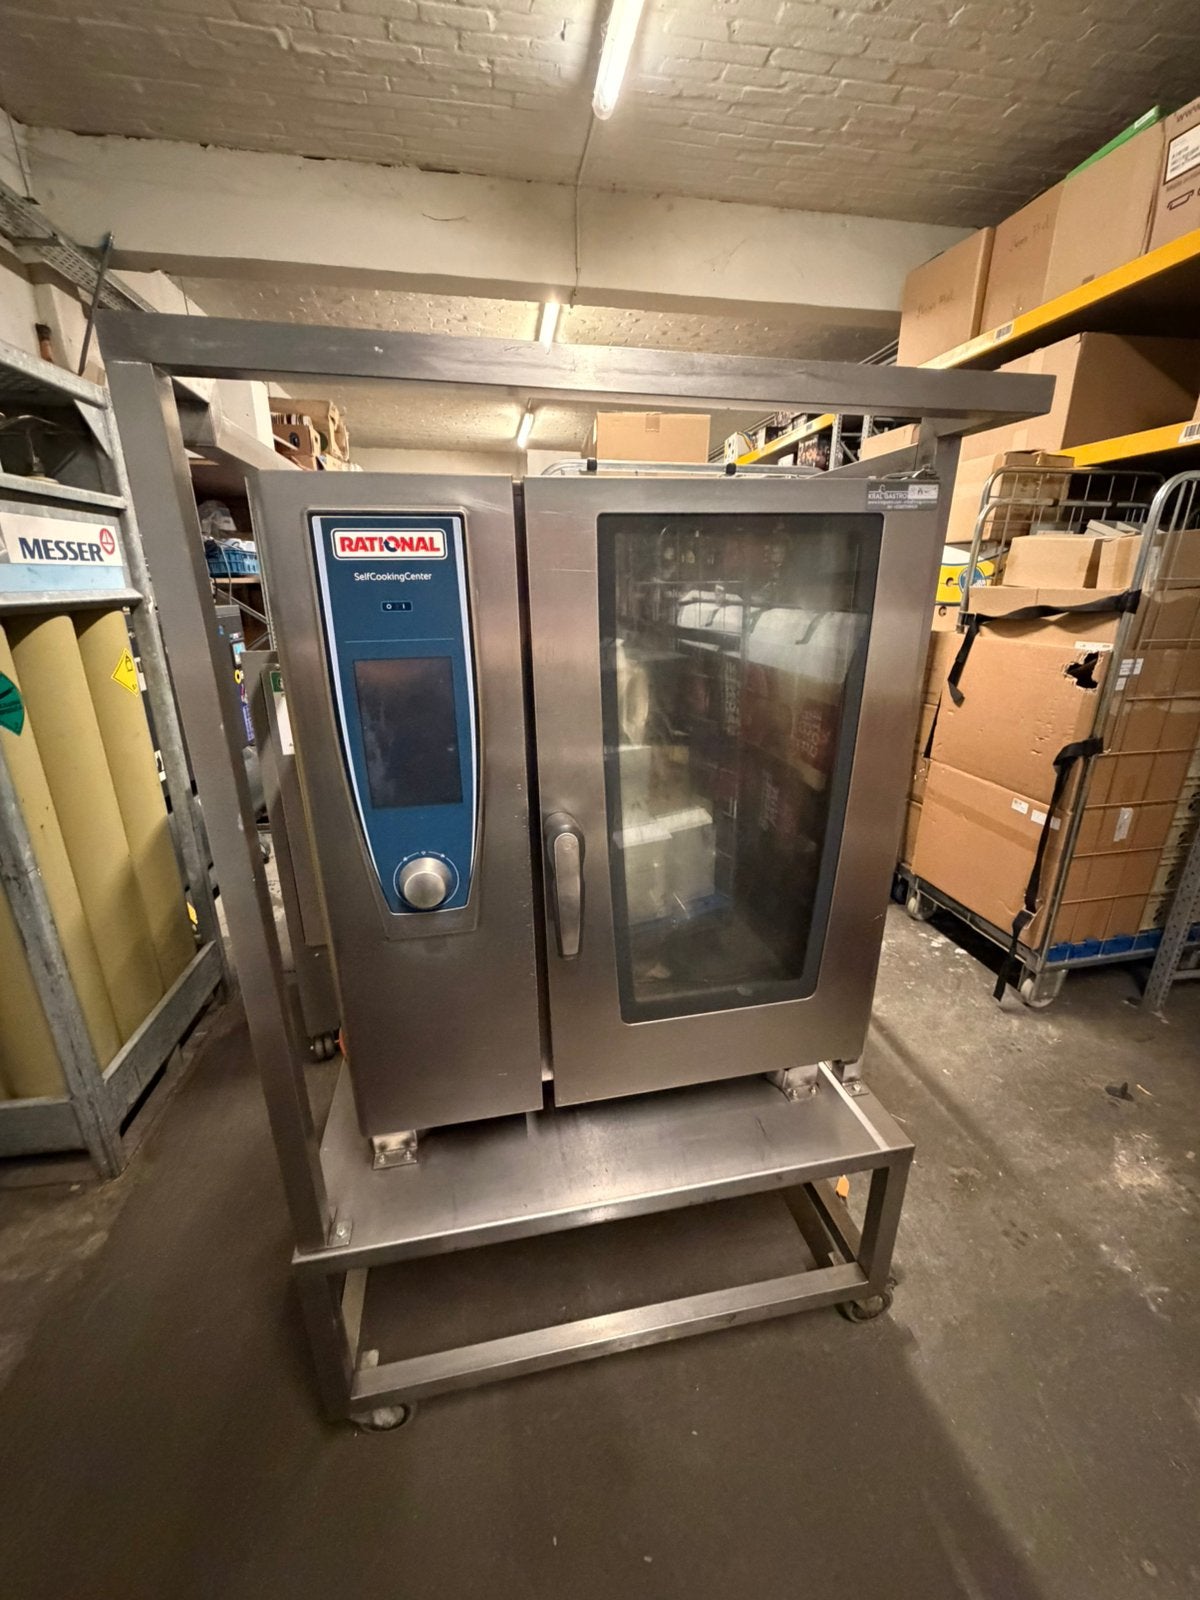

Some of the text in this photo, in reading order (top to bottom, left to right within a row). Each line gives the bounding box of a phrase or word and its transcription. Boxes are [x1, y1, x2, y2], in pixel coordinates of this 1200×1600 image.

[18, 536, 104, 562] MESSER
[339, 535, 441, 553] RATIONAL
[353, 571, 432, 583] SelfCookingCenter
